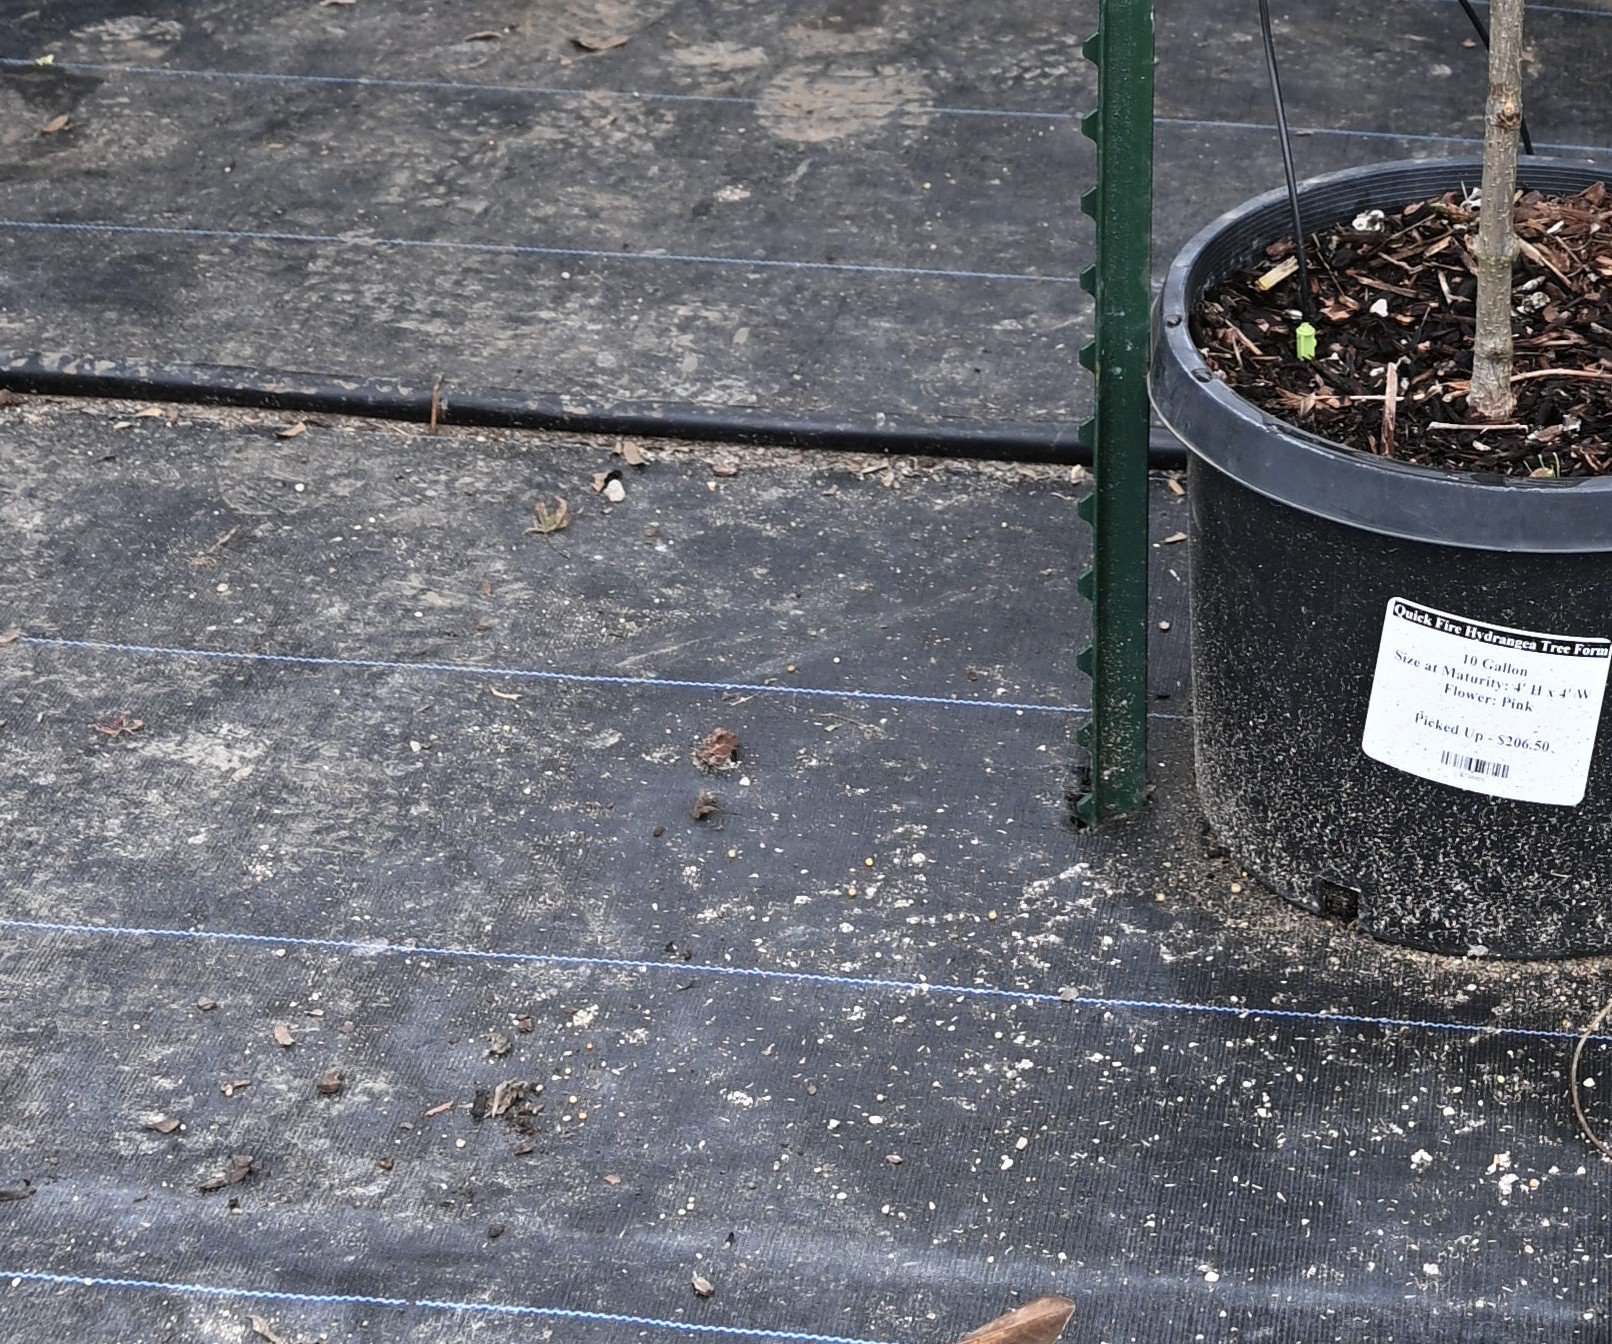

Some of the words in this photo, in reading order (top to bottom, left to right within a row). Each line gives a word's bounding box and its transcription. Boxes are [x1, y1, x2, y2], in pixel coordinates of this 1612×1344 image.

[1393, 603, 1433, 626] Quick
[1434, 617, 1462, 635] Fire
[1464, 625, 1536, 651] Hydrangea
[1540, 640, 1571, 655] Tree
[1573, 643, 1609, 657] Form
[1393, 649, 1420, 667] Size
[1424, 661, 1438, 674] at
[1442, 664, 1509, 693] Maturity:
[1530, 684, 1542, 697] H
[1576, 688, 1590, 700] W
[1462, 653, 1478, 667] 10
[1482, 658, 1528, 677] Gallon
[1444, 682, 1496, 706] Flower:
[1501, 696, 1534, 712] Pink
[1414, 712, 1459, 735] Picked
[1464, 726, 1484, 742] Up
[1497, 734, 1550, 753] $206.50
